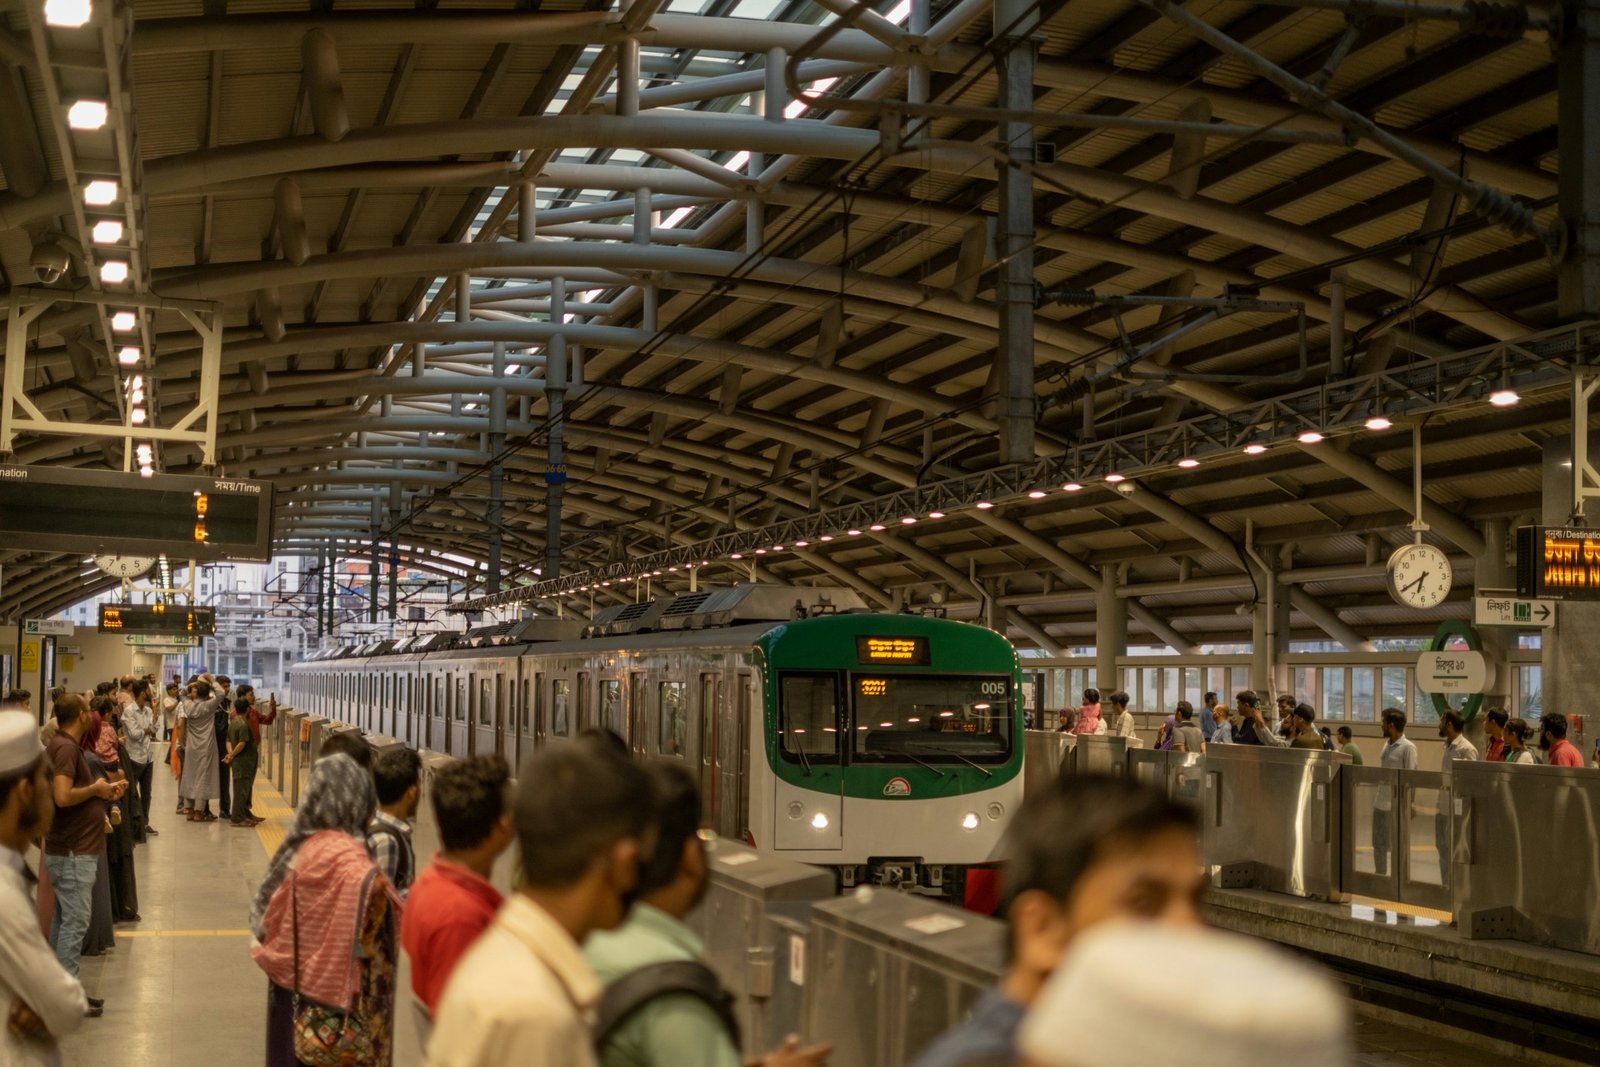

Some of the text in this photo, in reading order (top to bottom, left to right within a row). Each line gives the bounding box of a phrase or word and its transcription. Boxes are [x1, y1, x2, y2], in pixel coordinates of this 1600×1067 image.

[1418, 550, 1426, 558] 12
[109, 559, 115, 567] 7
[120, 563, 127, 571] 6
[134, 560, 140, 568] 5
[981, 682, 1005, 695] 005
